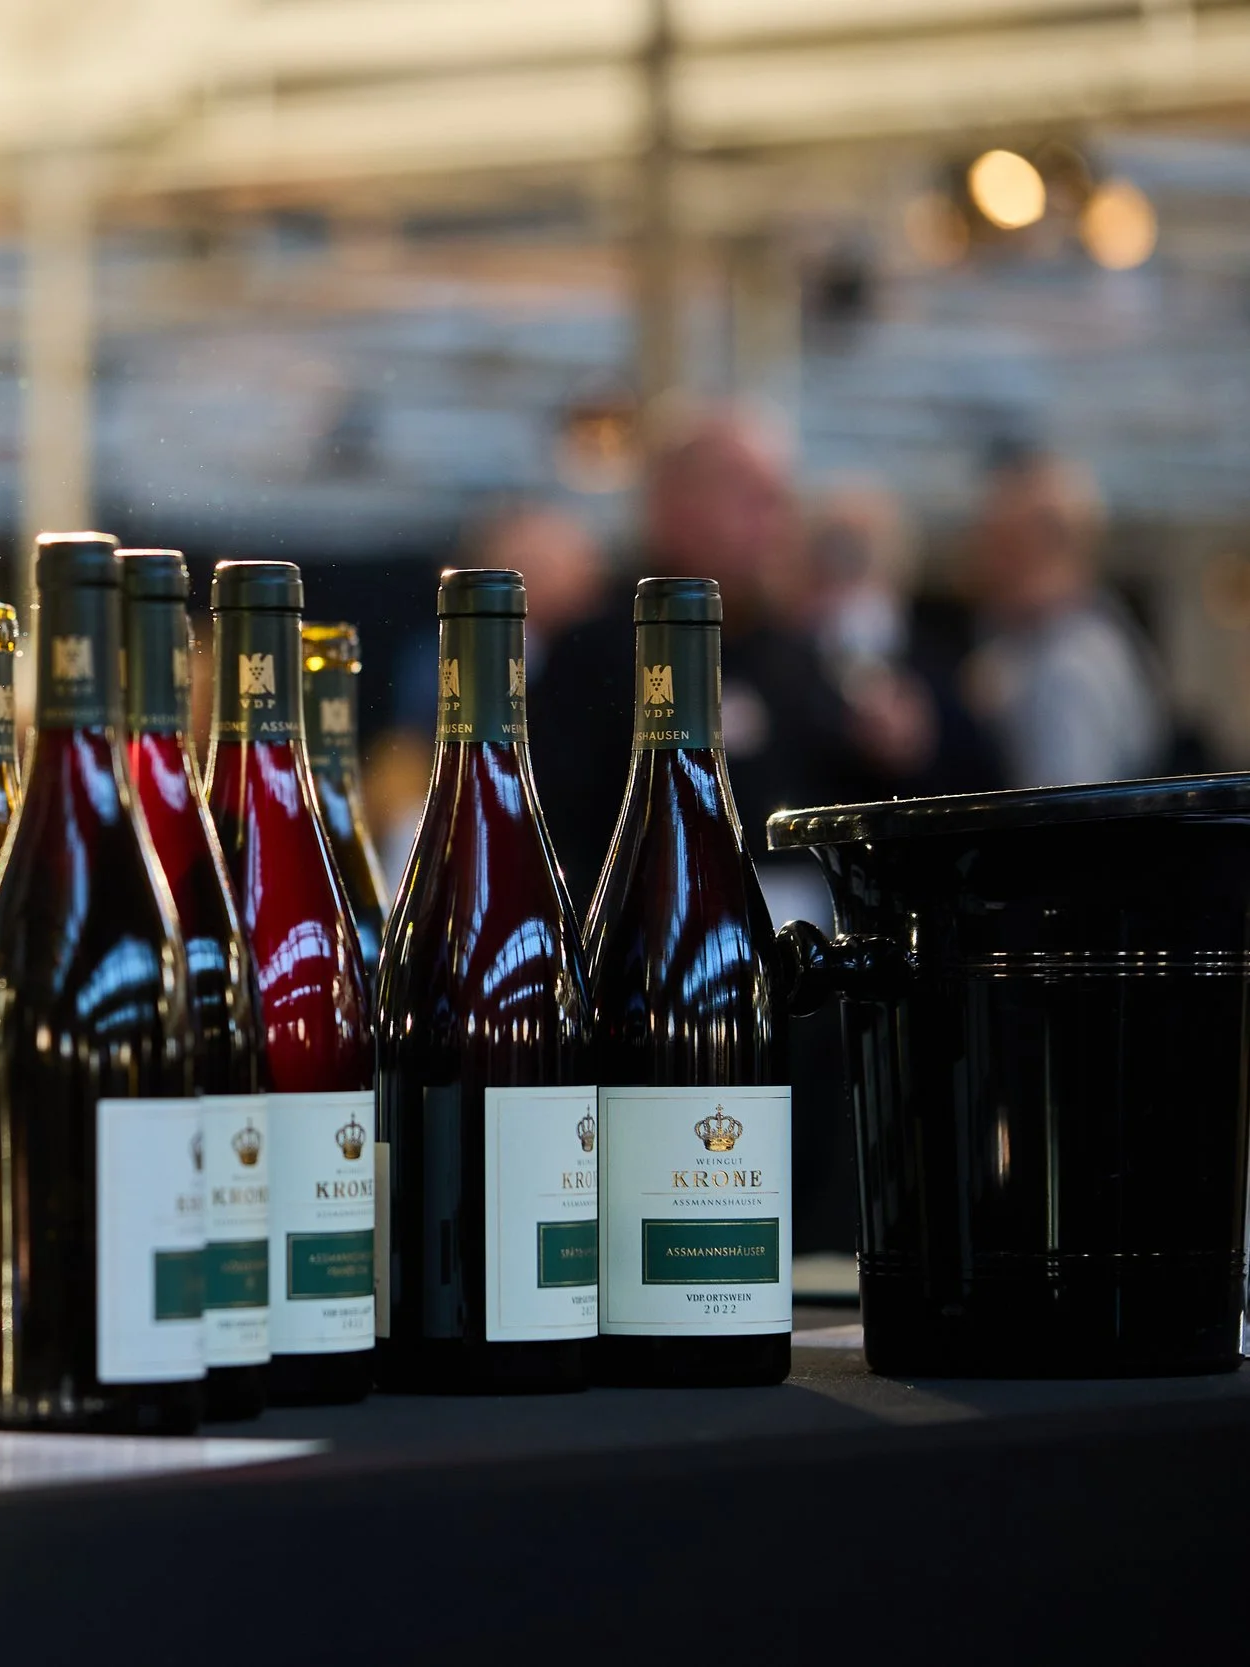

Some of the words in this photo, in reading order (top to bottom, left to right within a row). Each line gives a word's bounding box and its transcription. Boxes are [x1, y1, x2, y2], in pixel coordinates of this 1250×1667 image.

[240, 699, 276, 709] VDP
[643, 708, 675, 718] VDP
[695, 1157, 744, 1166] WEINGUT
[670, 1169, 764, 1189] KRONE
[672, 1197, 764, 1207] ASSMANNSHAUSEN
[665, 1246, 766, 1258] ASSMANNSHÄUSER
[704, 1305, 737, 1315] 2022
